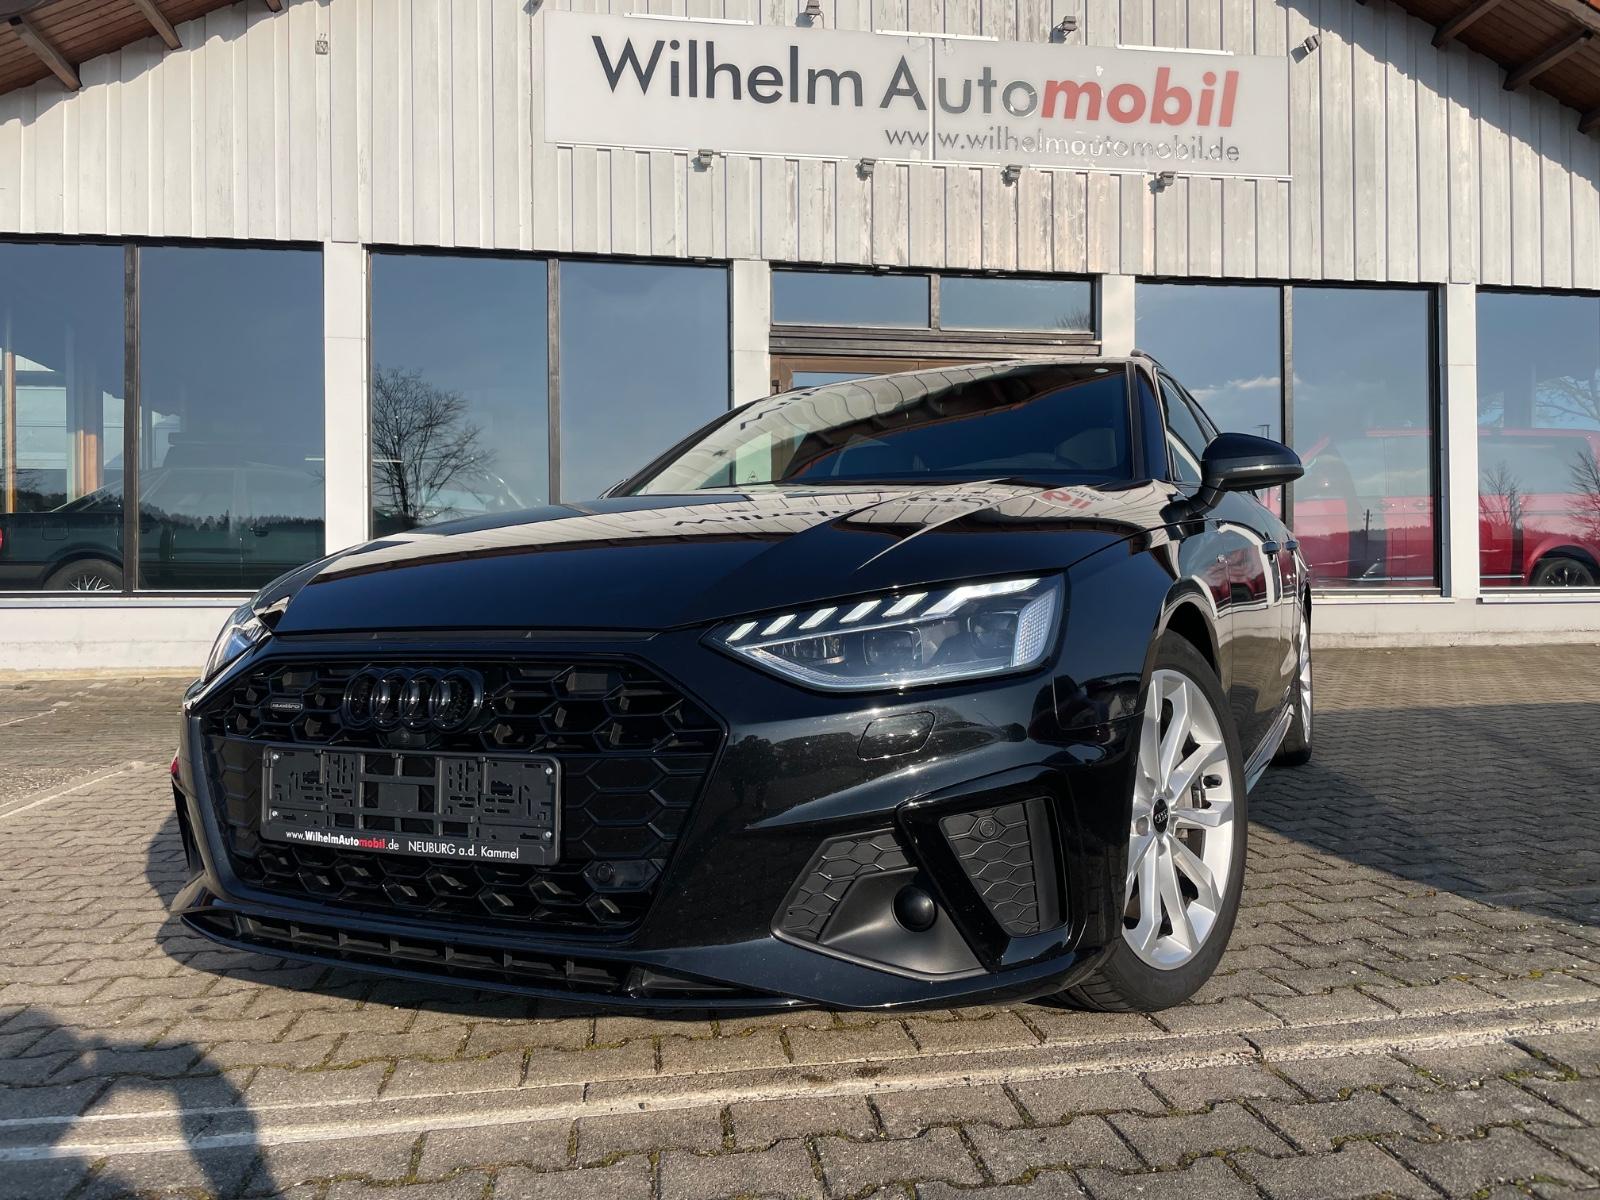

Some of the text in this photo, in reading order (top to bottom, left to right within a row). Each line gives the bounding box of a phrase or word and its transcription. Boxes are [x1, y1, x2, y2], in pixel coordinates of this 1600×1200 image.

[591, 35, 1240, 127] Wilhelm Automobil
[884, 125, 1240, 162] www.wilhelmautomobil.de
[285, 830, 519, 859] www.WilhelmAutomobil.de NEUBURG a.d. Kammel
